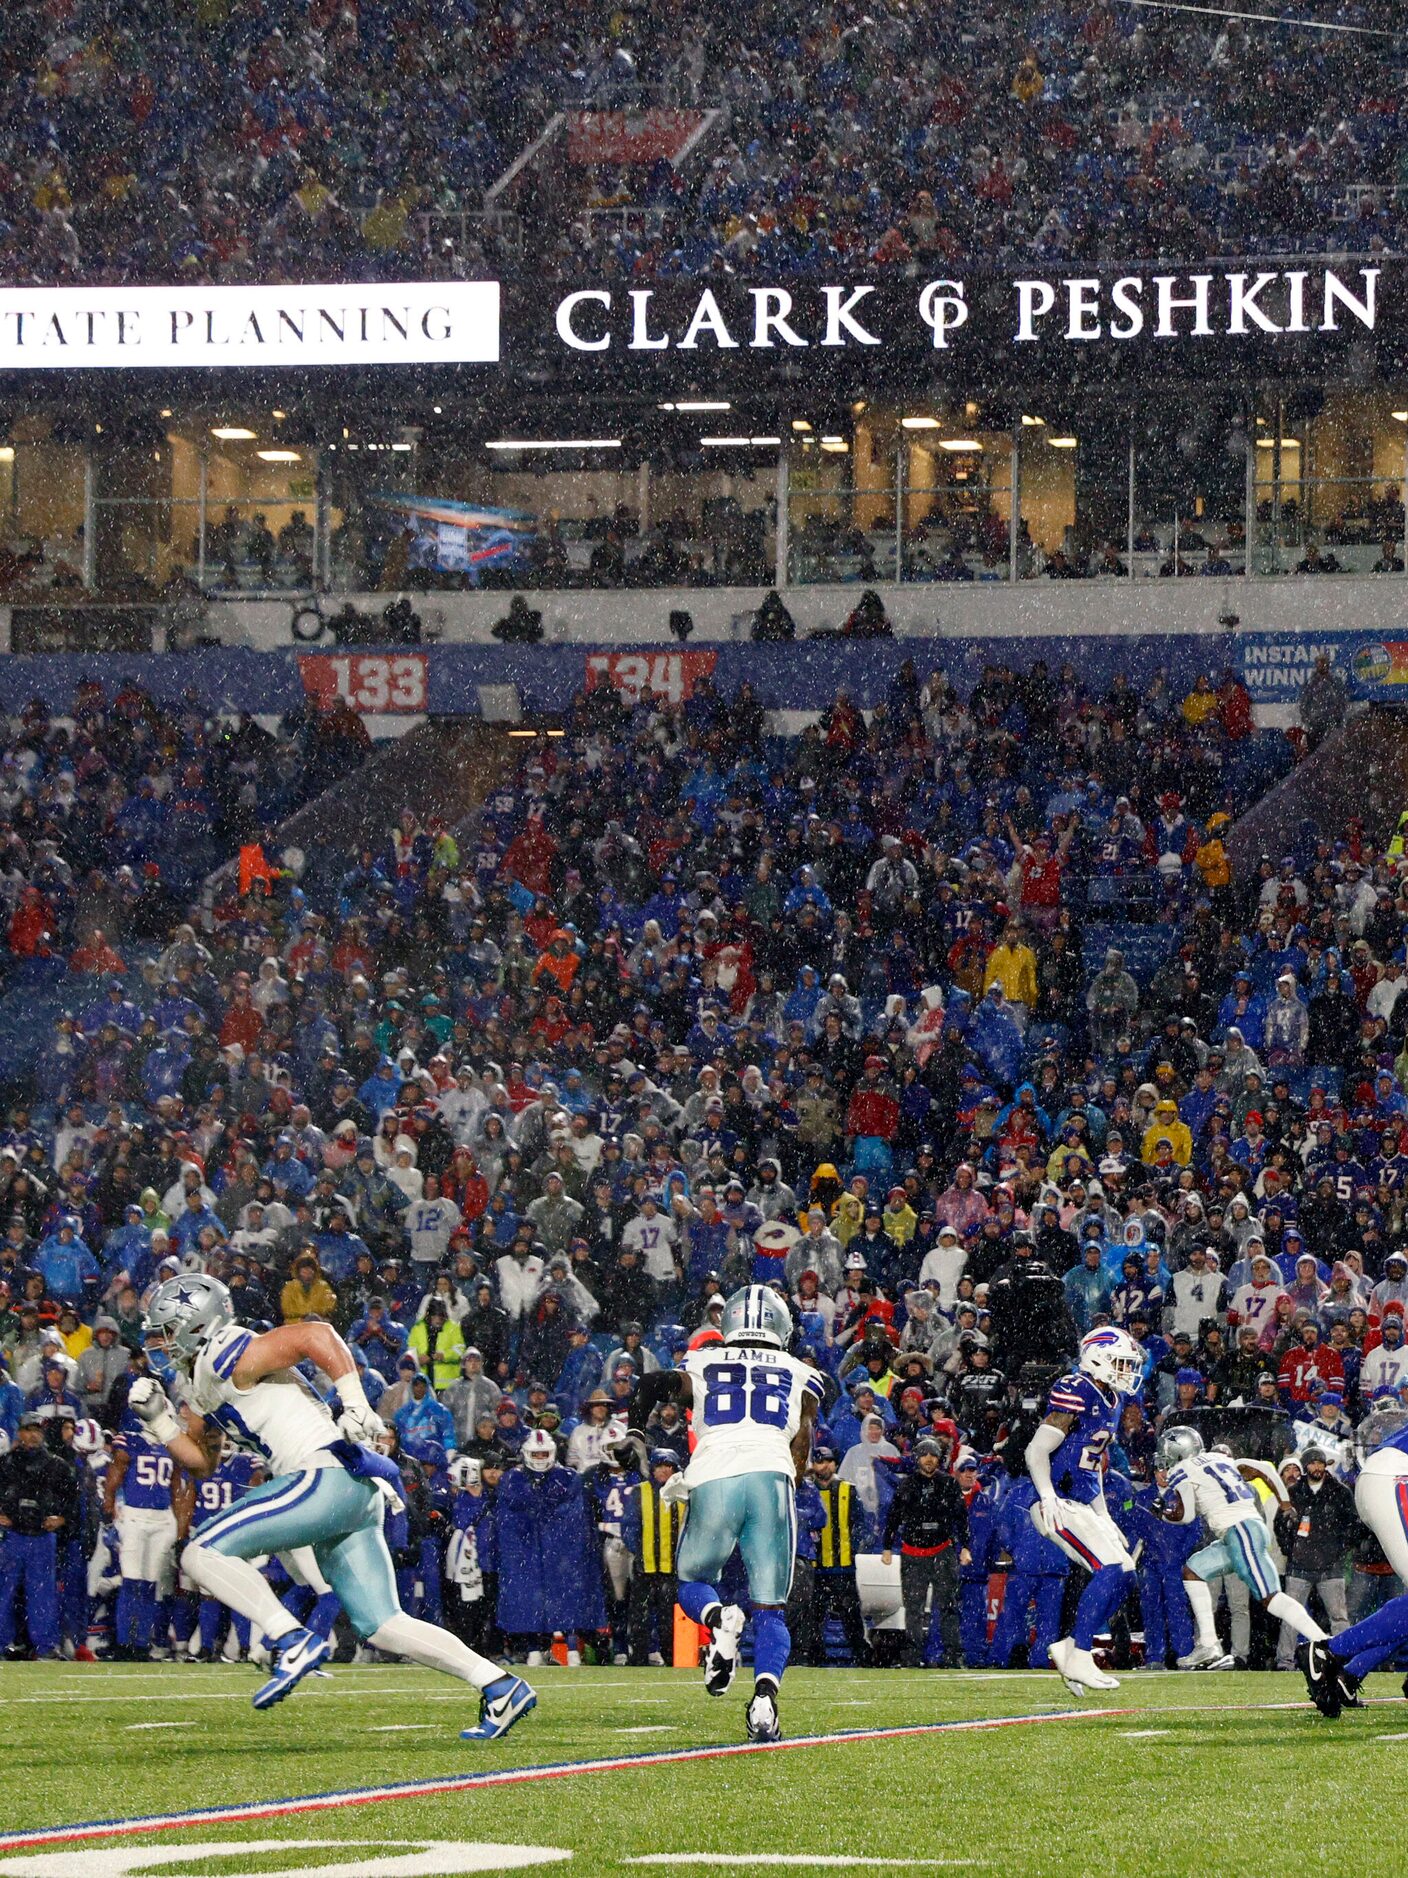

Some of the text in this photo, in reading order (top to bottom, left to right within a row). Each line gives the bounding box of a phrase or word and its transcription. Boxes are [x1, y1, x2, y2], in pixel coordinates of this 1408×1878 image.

[555, 285, 881, 351] CLARK
[1013, 269, 1381, 341] PESHKIN
[5, 306, 454, 345] TATE PLANNING
[1244, 644, 1339, 664] INSTANT
[331, 658, 425, 706] 133
[1102, 843, 1119, 860] 21
[600, 1112, 621, 1133] 17
[1378, 1168, 1397, 1186] 17
[415, 1209, 442, 1232] 12
[640, 1227, 659, 1248] 17
[1191, 1284, 1205, 1303] 4
[1116, 1290, 1145, 1323] 12
[1246, 1297, 1267, 1318] 17
[724, 1349, 777, 1364] LAMB
[1295, 1365, 1318, 1387] 14
[1379, 1362, 1400, 1385] 17
[703, 1362, 793, 1430] 88
[1294, 1425, 1338, 1449] SANTA
[136, 1456, 174, 1487] 50
[1203, 1462, 1256, 1504] 13
[201, 1481, 233, 1510] 91
[605, 1487, 633, 1518] 4
